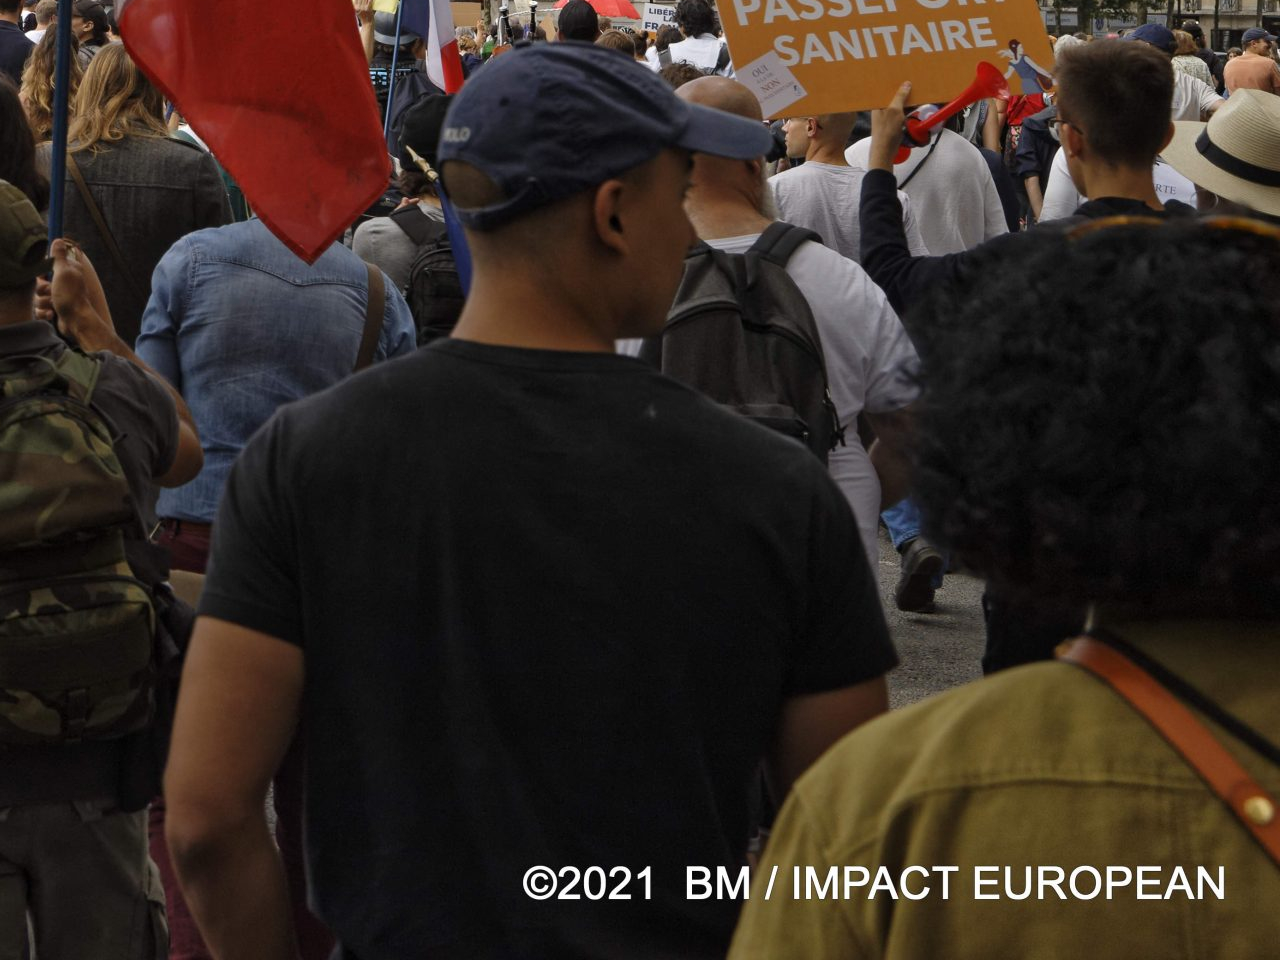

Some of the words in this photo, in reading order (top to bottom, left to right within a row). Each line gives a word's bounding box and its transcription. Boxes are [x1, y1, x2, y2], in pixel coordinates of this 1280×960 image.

[648, 7, 675, 17] LIBÉR
[774, 16, 998, 68] SANITAIRE
[1155, 183, 1177, 195] RTE
